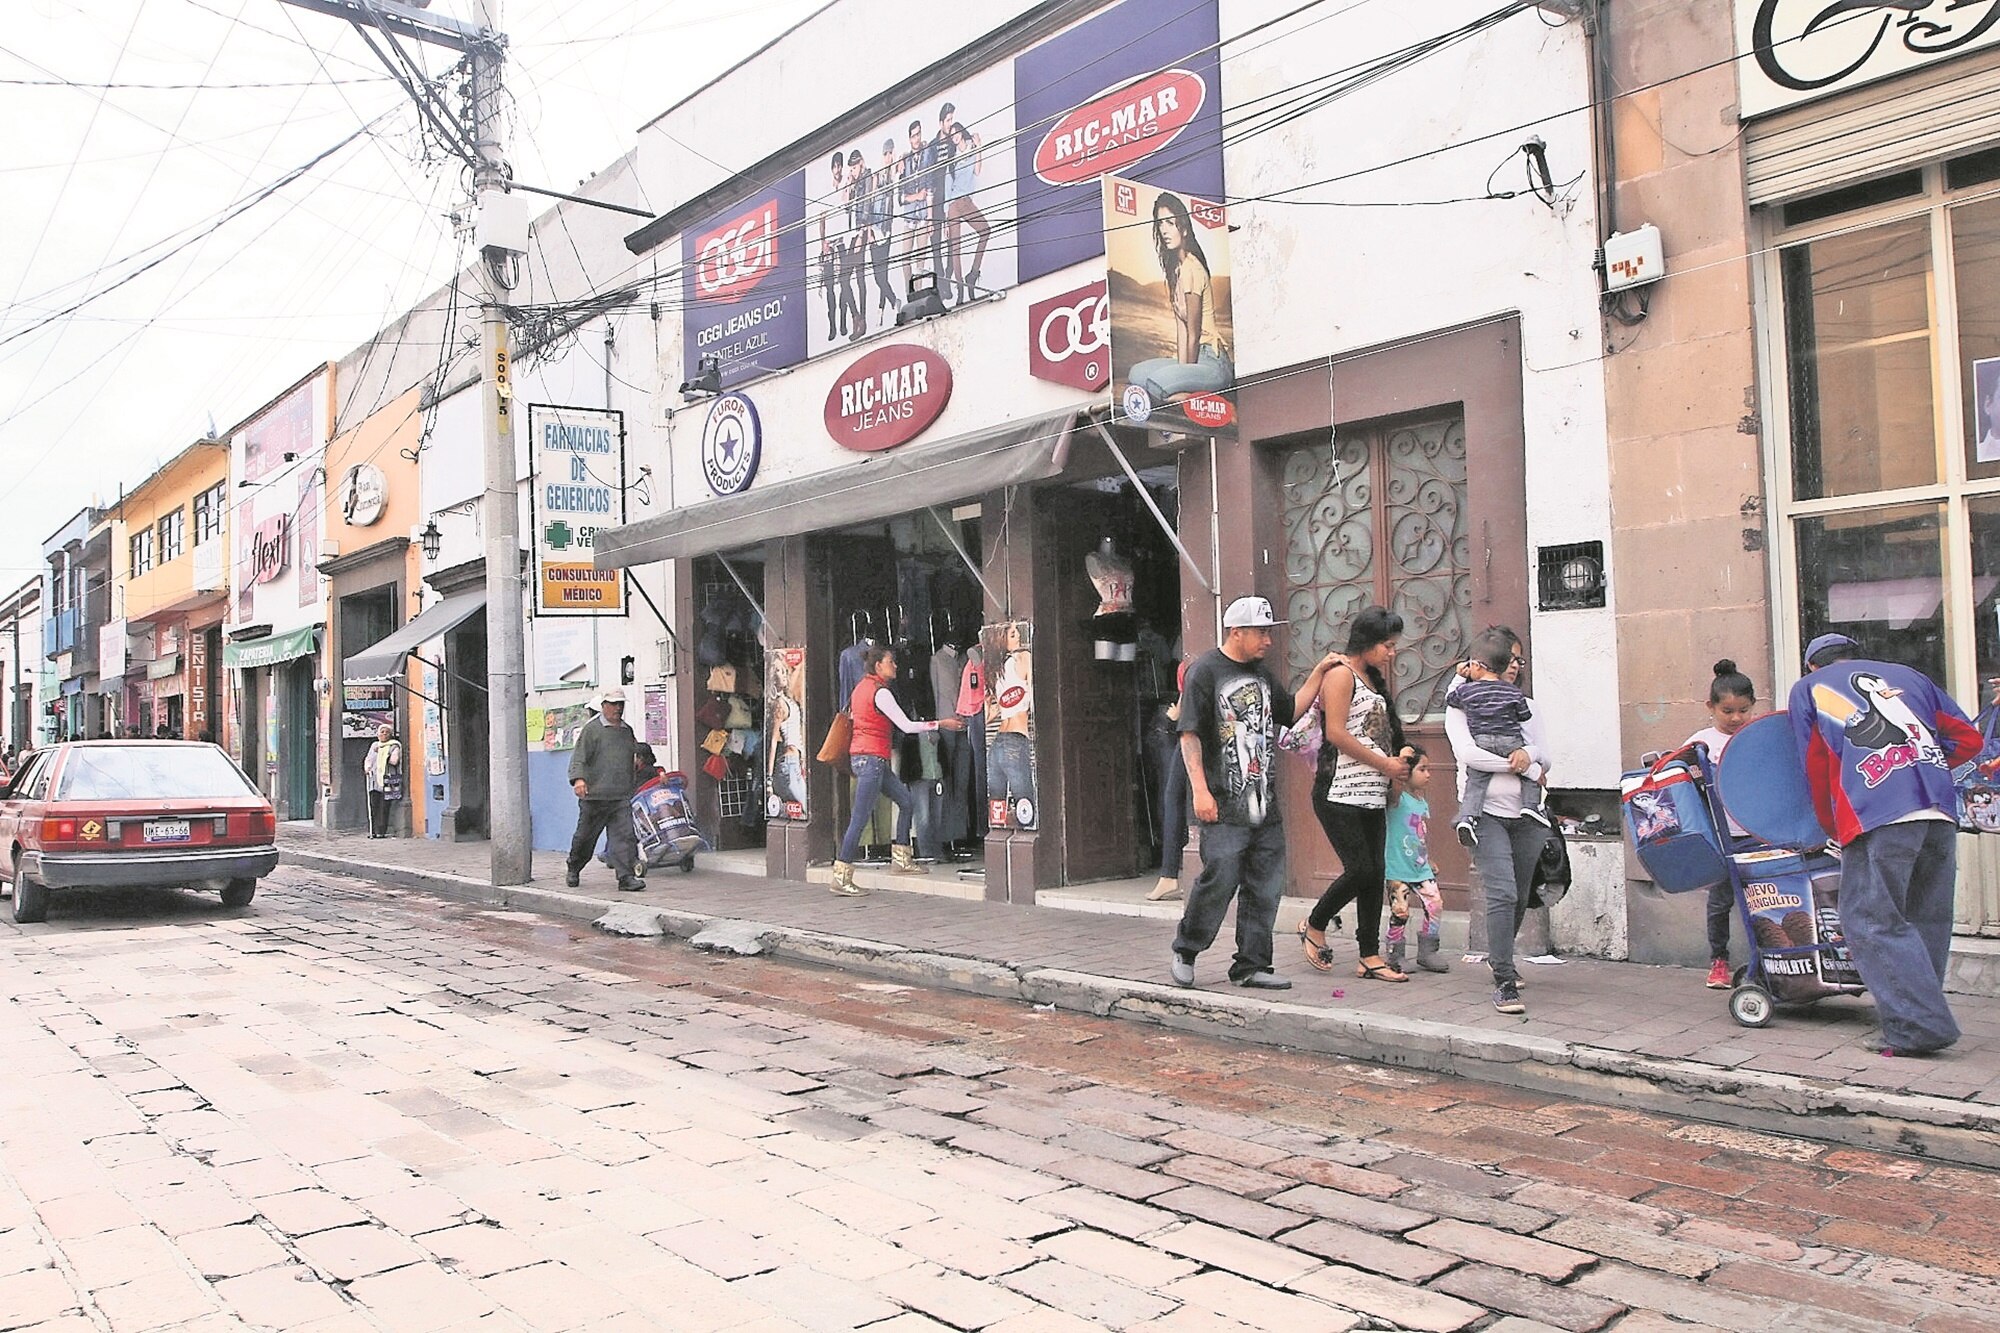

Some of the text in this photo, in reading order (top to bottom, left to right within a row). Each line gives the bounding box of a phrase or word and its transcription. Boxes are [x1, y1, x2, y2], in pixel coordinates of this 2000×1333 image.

[1055, 86, 1178, 161] RIC-MAR
[1071, 121, 1159, 168] JEANS
[1193, 204, 1224, 224] OGGI
[700, 209, 772, 293] OGGI
[697, 325, 723, 347] OGGI
[725, 308, 762, 337] JEANS
[1039, 292, 1110, 362] OG
[734, 341, 745, 358] EL
[841, 360, 928, 417] RIC-MAR
[712, 399, 745, 424] FUROR
[852, 401, 914, 433] JEANS
[1190, 399, 1226, 414] RIC-MAR
[1196, 411, 1222, 421] JEANS
[545, 424, 610, 454] FARMACIAS
[571, 456, 586, 482] DE
[706, 450, 751, 491] PRODUCTS
[547, 485, 609, 513] GENERICOS
[579, 526, 609, 537] CR
[252, 519, 281, 577] flexi
[548, 567, 615, 582] CONSULTORIO
[563, 585, 602, 601] MÉDICO
[239, 644, 274, 662] ZAPATERIA
